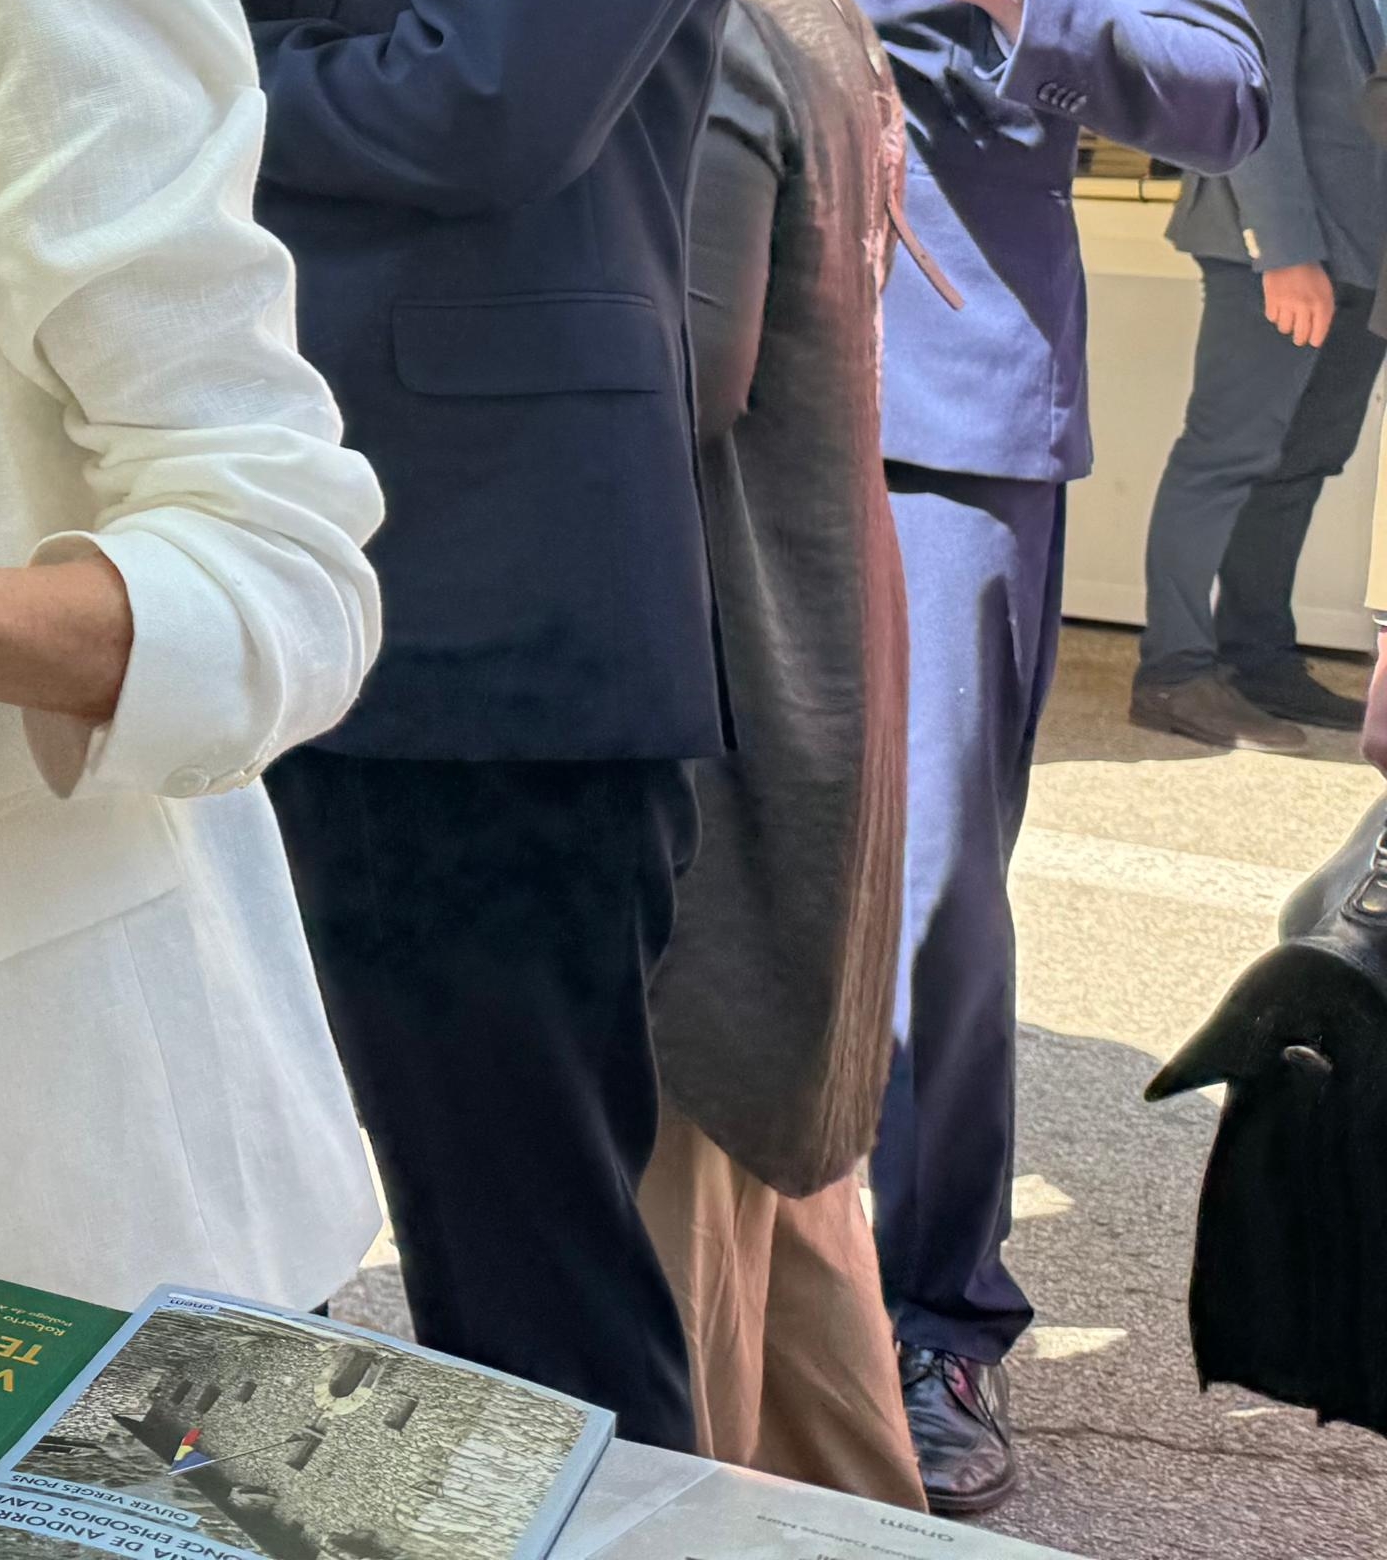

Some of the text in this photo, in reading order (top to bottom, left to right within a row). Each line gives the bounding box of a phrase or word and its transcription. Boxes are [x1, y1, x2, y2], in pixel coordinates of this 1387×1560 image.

[2, 1315, 66, 1337] Roberto
[10, 1474, 190, 1522] OLIVER VERGÉS PONS
[58, 1505, 174, 1547] EPISODIOS
[110, 1536, 145, 1553] DE
